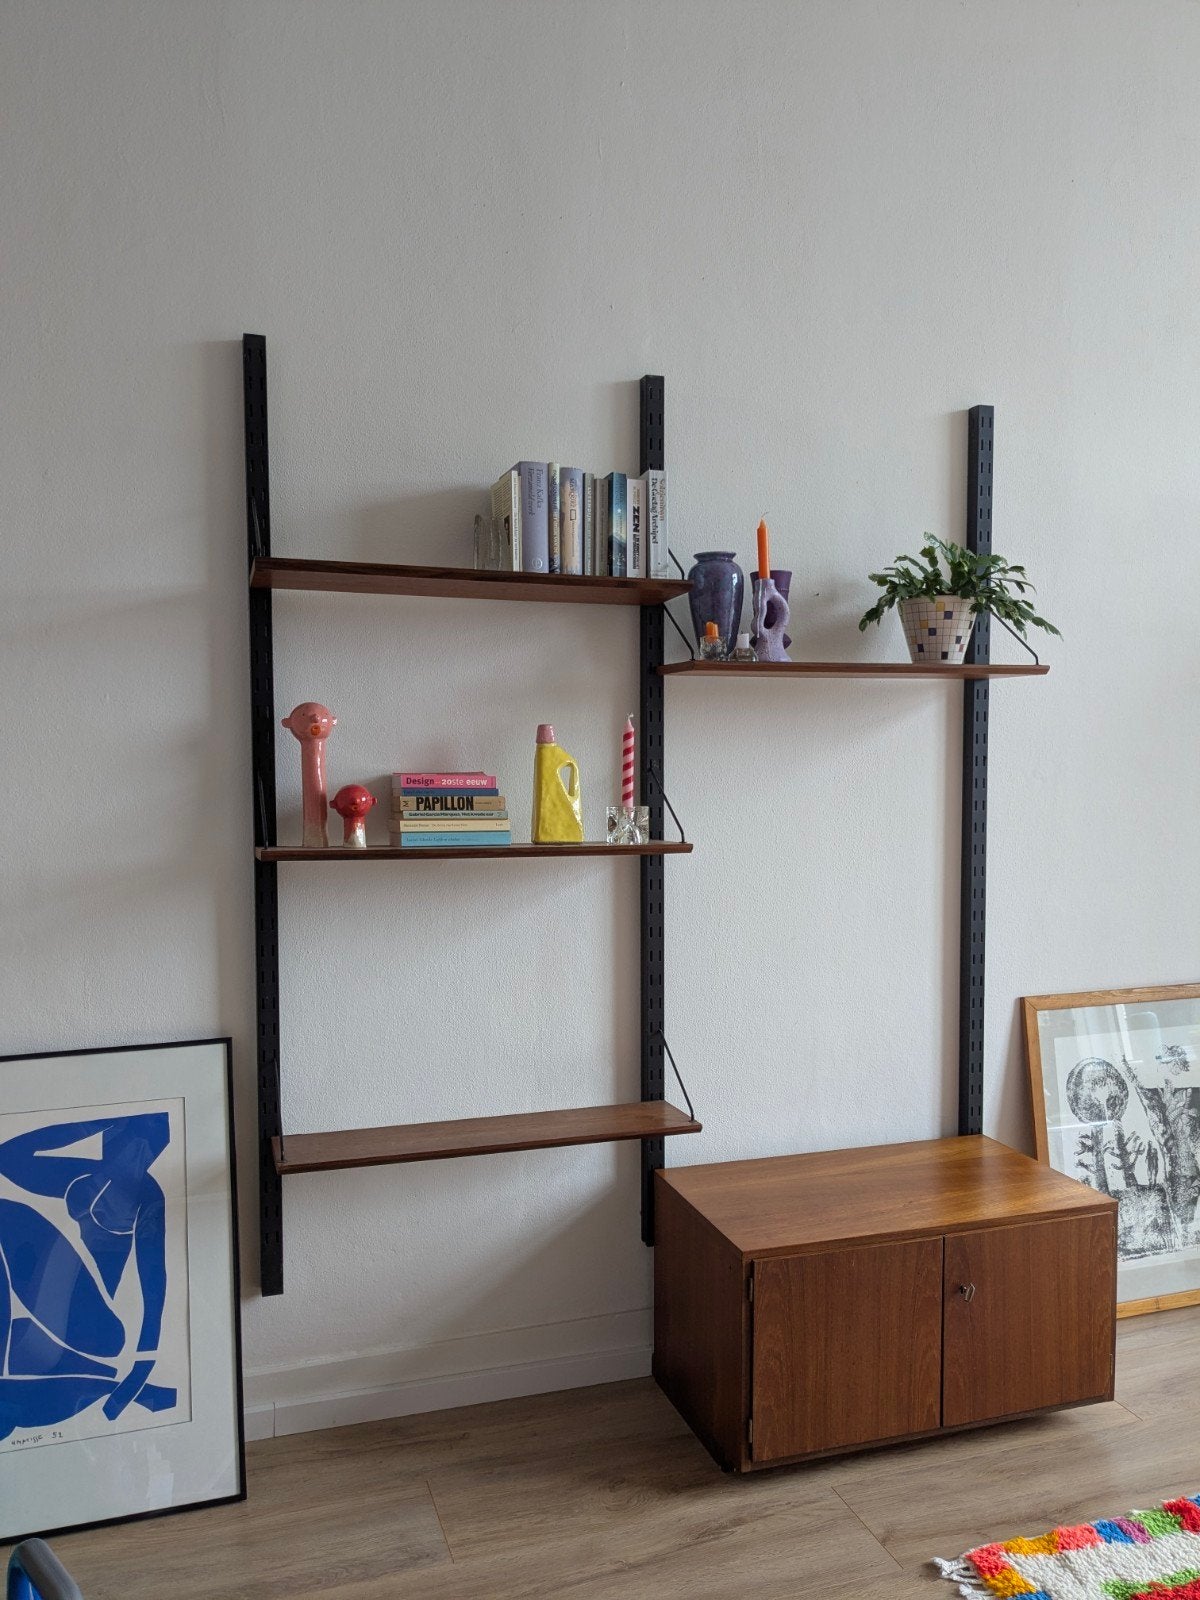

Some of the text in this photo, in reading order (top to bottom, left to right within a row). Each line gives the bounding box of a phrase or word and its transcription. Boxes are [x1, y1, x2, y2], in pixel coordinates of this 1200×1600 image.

[527, 467, 536, 517] Verzameld werk
[536, 468, 544, 509] Franz Kafka
[632, 505, 641, 533] ZEN
[650, 513, 659, 545] Archipel
[406, 776, 488, 787] Design 20ste eeuw
[416, 796, 474, 811] PAPILLON
